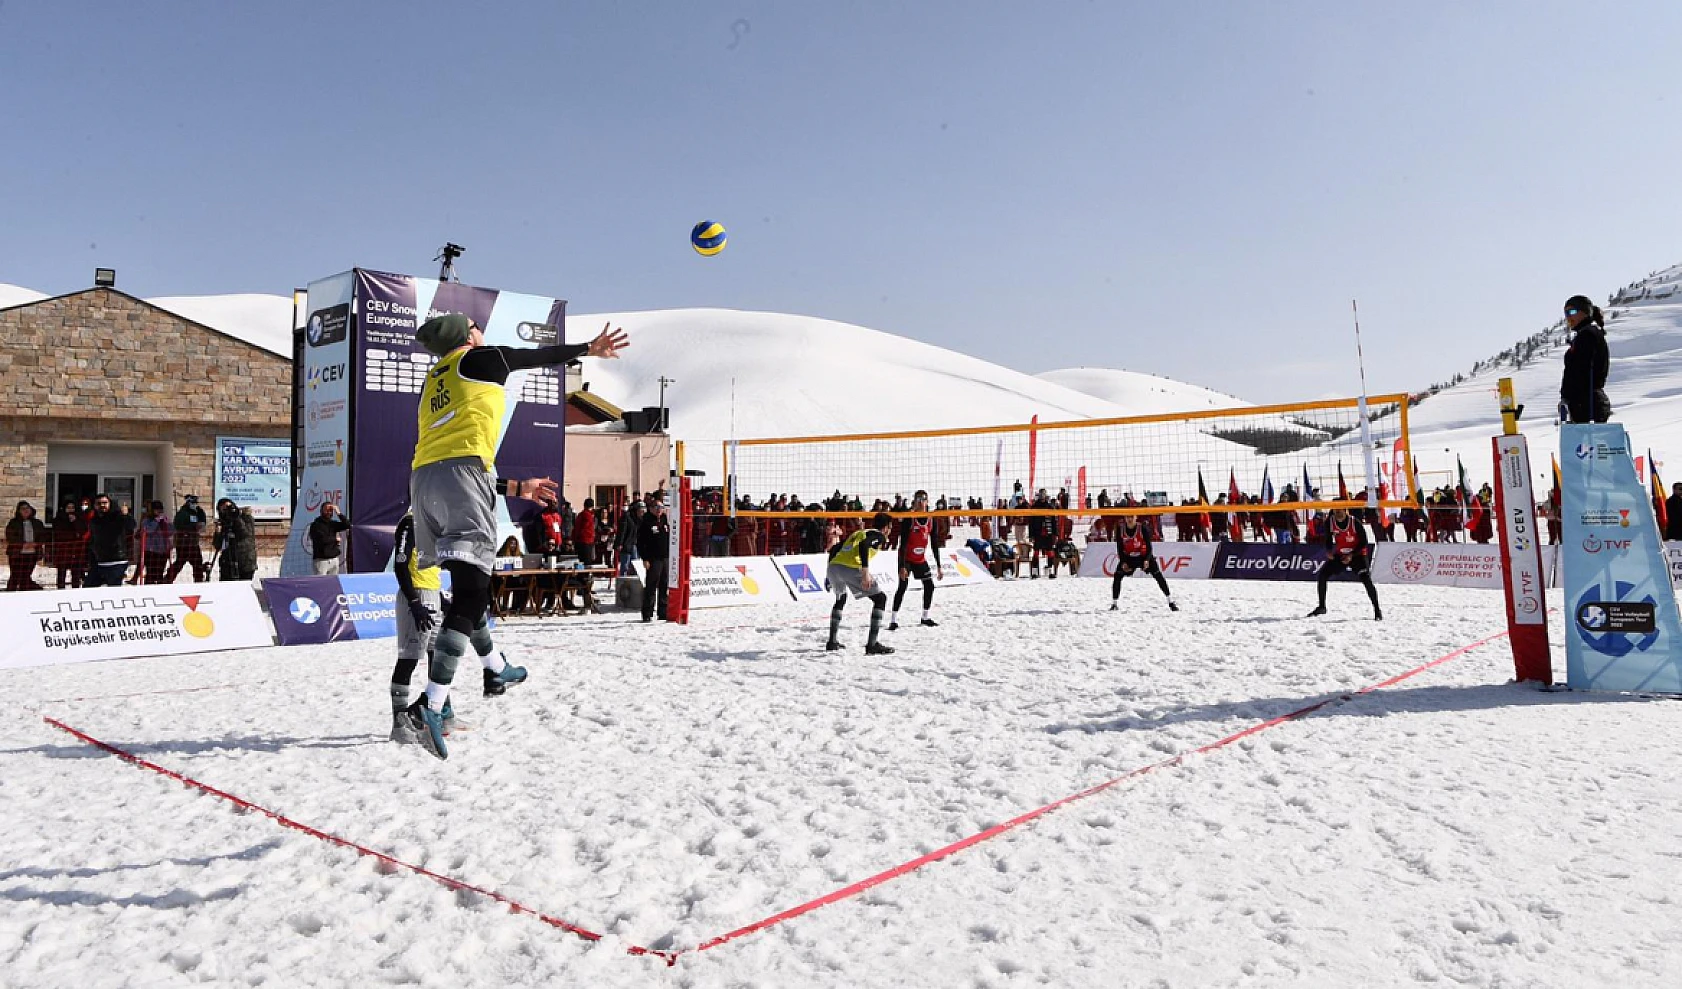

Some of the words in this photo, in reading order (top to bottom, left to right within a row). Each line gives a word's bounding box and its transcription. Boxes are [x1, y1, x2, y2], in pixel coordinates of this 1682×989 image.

[366, 300, 389, 312] CEV
[366, 313, 415, 327] European
[322, 363, 345, 382] CEV
[430, 389, 451, 412] RUS
[223, 457, 243, 465] KAR
[1513, 508, 1526, 534] CEV
[1604, 540, 1632, 550] TVF
[1159, 556, 1192, 572] VF
[1225, 555, 1326, 574] EuroVolley
[1440, 554, 1482, 562] REPUBLIC
[1483, 555, 1496, 563] OF
[1522, 570, 1533, 594] TVF
[337, 593, 365, 605] CEV
[40, 613, 175, 632] Kahramanmaraş
[341, 609, 397, 621] Europea
[44, 632, 115, 649] Büyükşehir
[120, 627, 181, 641] Belediyesi
